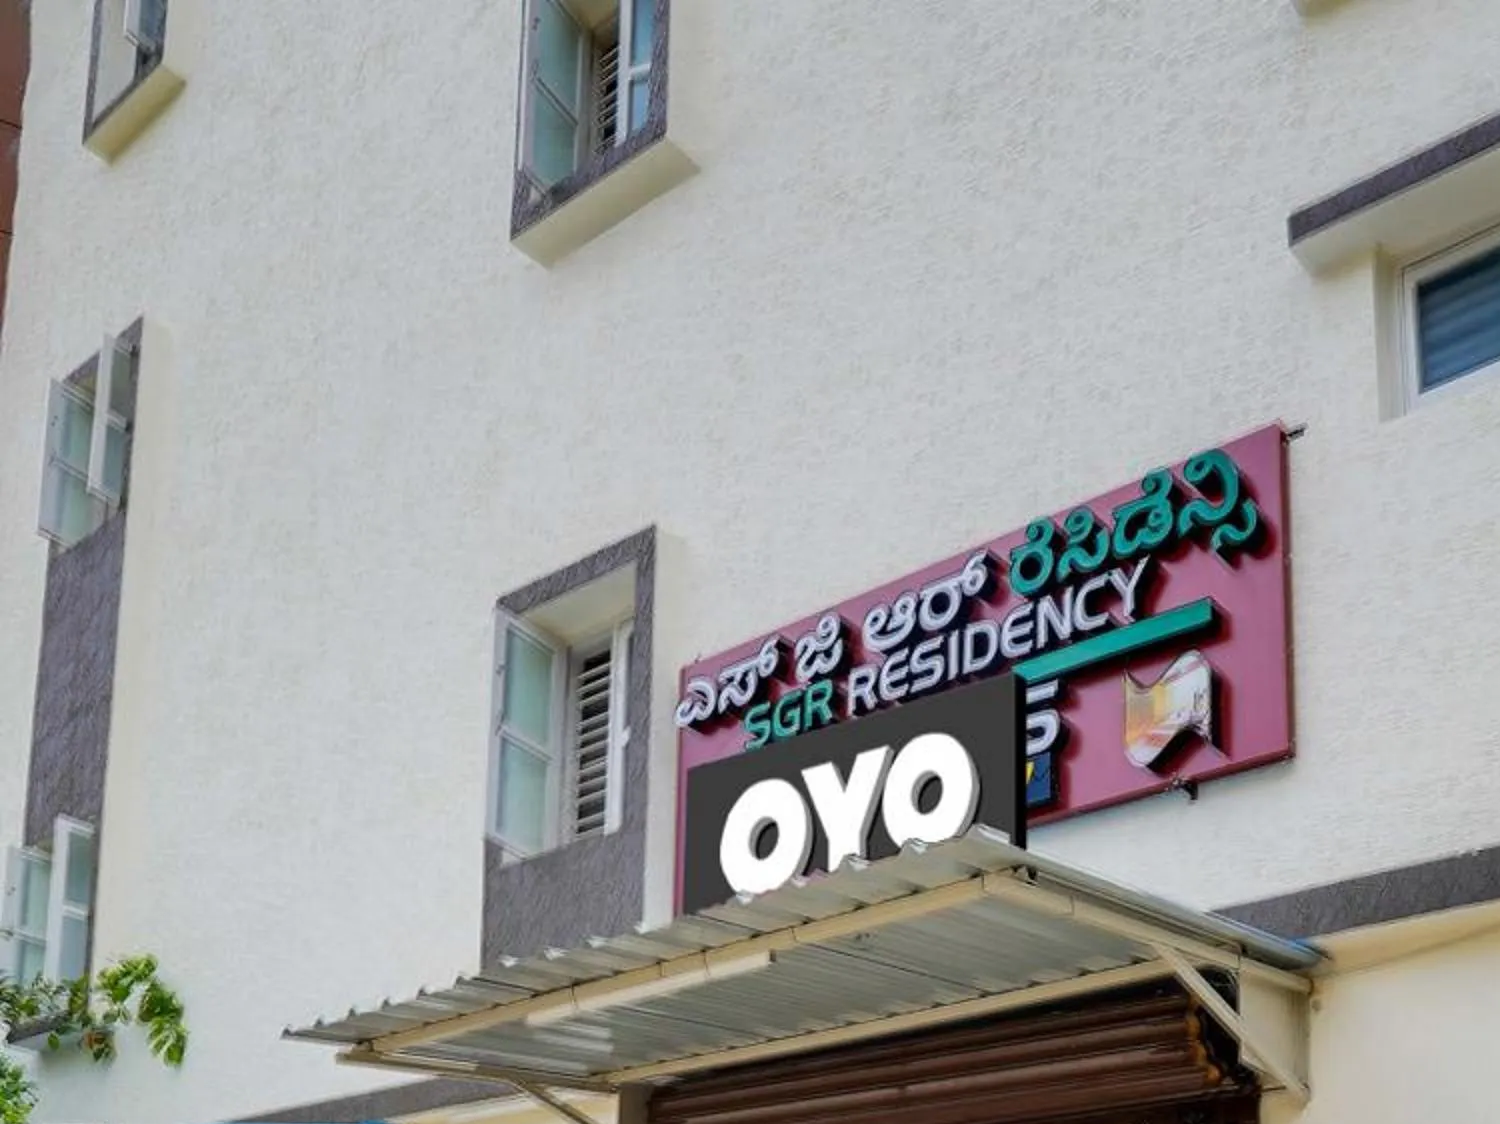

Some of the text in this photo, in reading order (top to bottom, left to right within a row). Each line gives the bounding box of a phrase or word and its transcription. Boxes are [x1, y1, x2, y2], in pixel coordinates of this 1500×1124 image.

[673, 635, 781, 727] ಎಸ್
[794, 612, 844, 682] ಜಿ
[1007, 449, 1258, 597] ರೆಸಿಡೆನ್ಸಿ
[742, 680, 835, 751] SGR
[847, 554, 1151, 718] RESIDENCY
[719, 732, 981, 895] OYO
